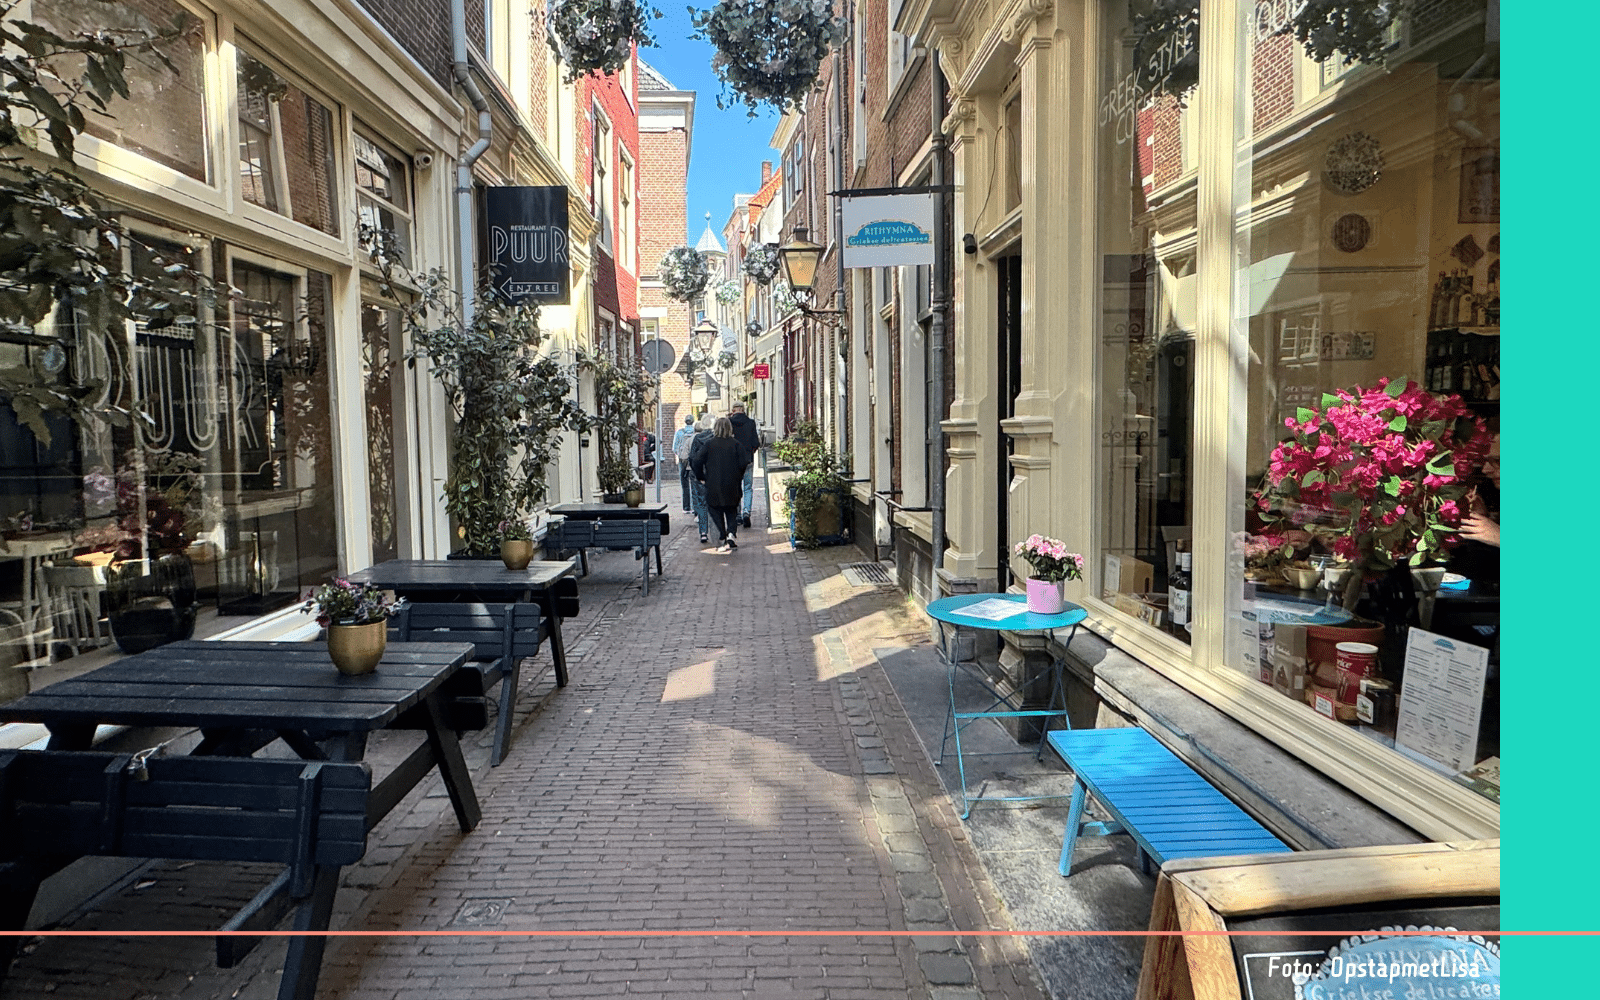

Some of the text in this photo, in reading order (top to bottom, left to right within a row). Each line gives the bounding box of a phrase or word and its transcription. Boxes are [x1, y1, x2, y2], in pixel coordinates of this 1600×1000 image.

[1099, 18, 1194, 128] GREEK STYLE
[491, 225, 569, 263] PUUR
[864, 225, 914, 236] RITHYMNA
[508, 284, 557, 292] ENTREE
[73, 307, 260, 457] PUUR
